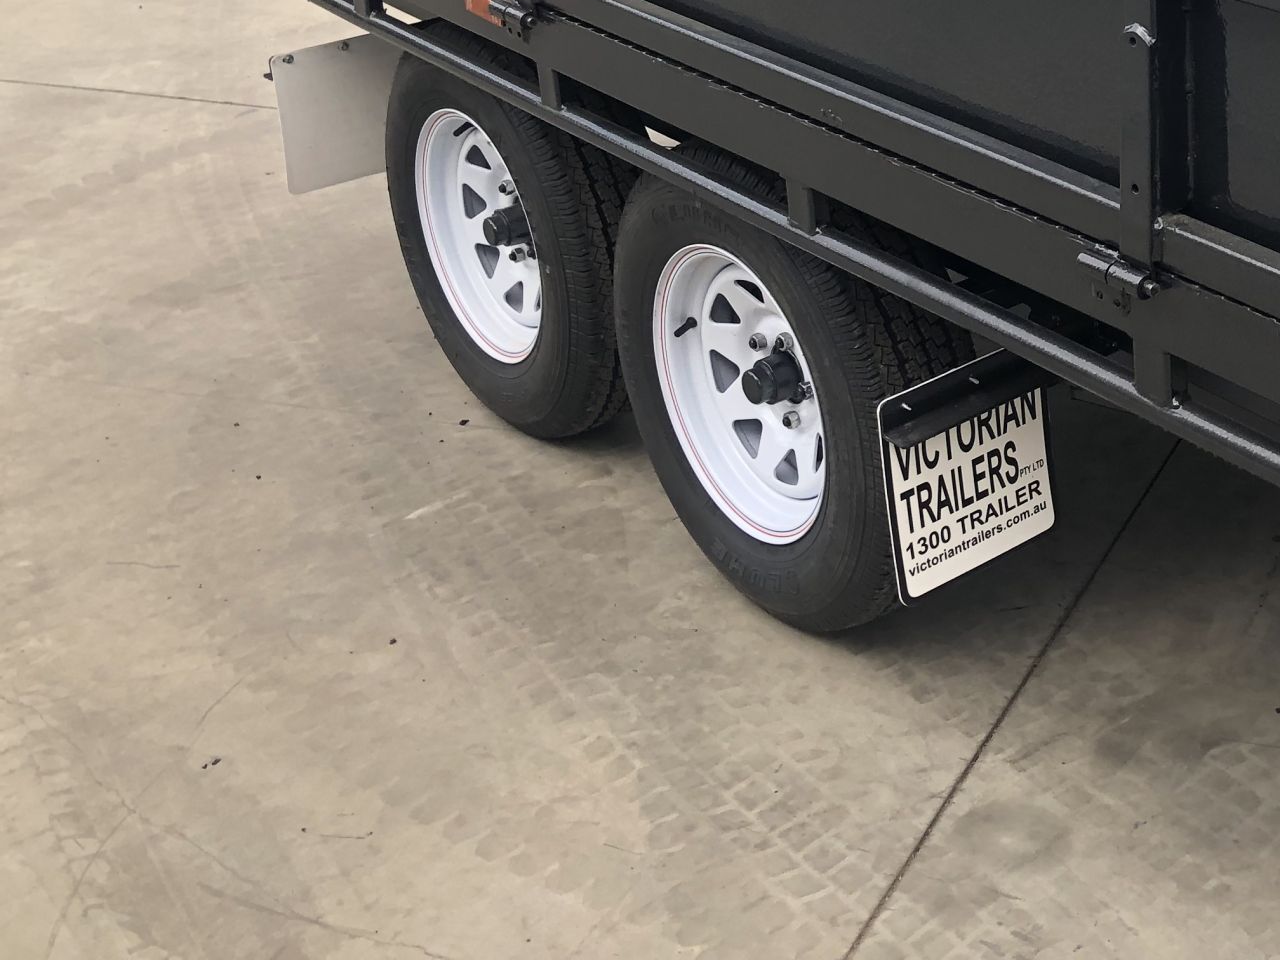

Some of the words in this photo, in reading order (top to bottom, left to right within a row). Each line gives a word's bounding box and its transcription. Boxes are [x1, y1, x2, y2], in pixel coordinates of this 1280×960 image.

[900, 440, 1019, 534] TRAILERS
[1019, 464, 1032, 478] PTY
[1032, 458, 1045, 471] LTD
[905, 525, 952, 560] 1300
[956, 479, 1042, 534] TRAILER
[908, 500, 1047, 577] victoriantrailers.com.au
